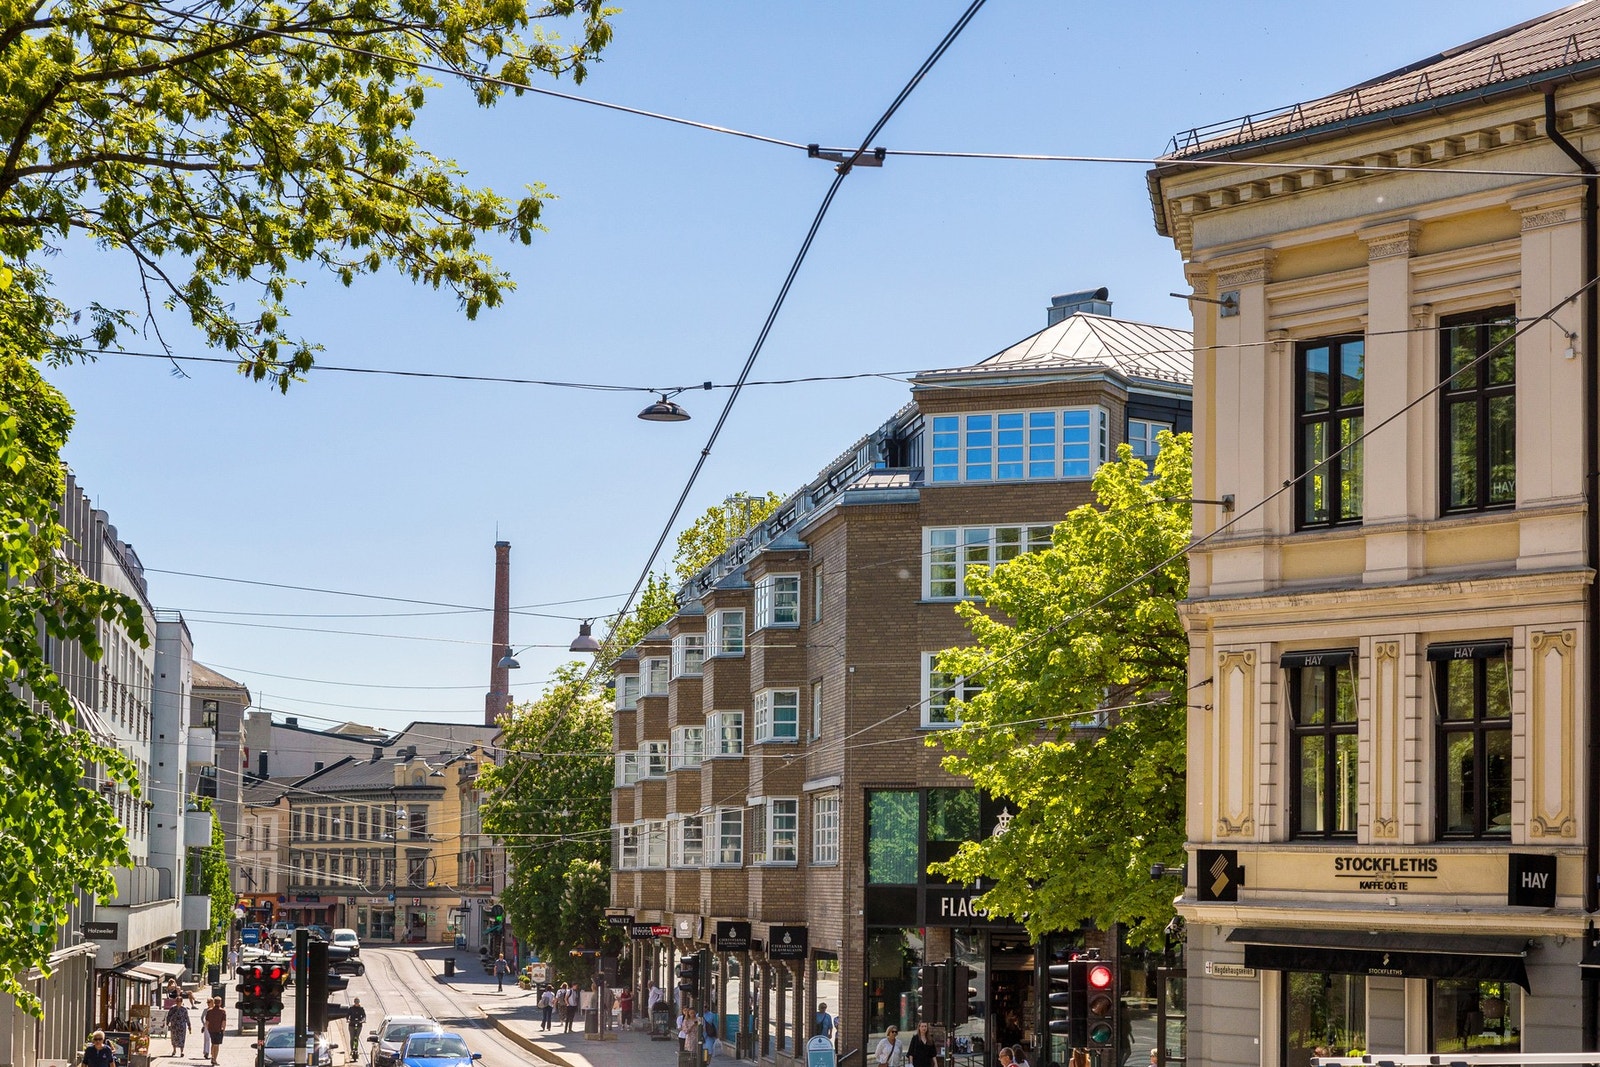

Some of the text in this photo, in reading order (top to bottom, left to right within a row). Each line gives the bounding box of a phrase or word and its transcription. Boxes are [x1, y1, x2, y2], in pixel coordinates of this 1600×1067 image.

[1493, 480, 1515, 494] HAY
[1453, 647, 1475, 658] HAY
[1304, 655, 1323, 666] HAY
[1335, 857, 1438, 872] STOCKFLETHS
[1522, 871, 1549, 889] HAY
[1360, 881, 1408, 891] KAFFE OG TE
[1368, 968, 1403, 976] STOCKFLETHS
